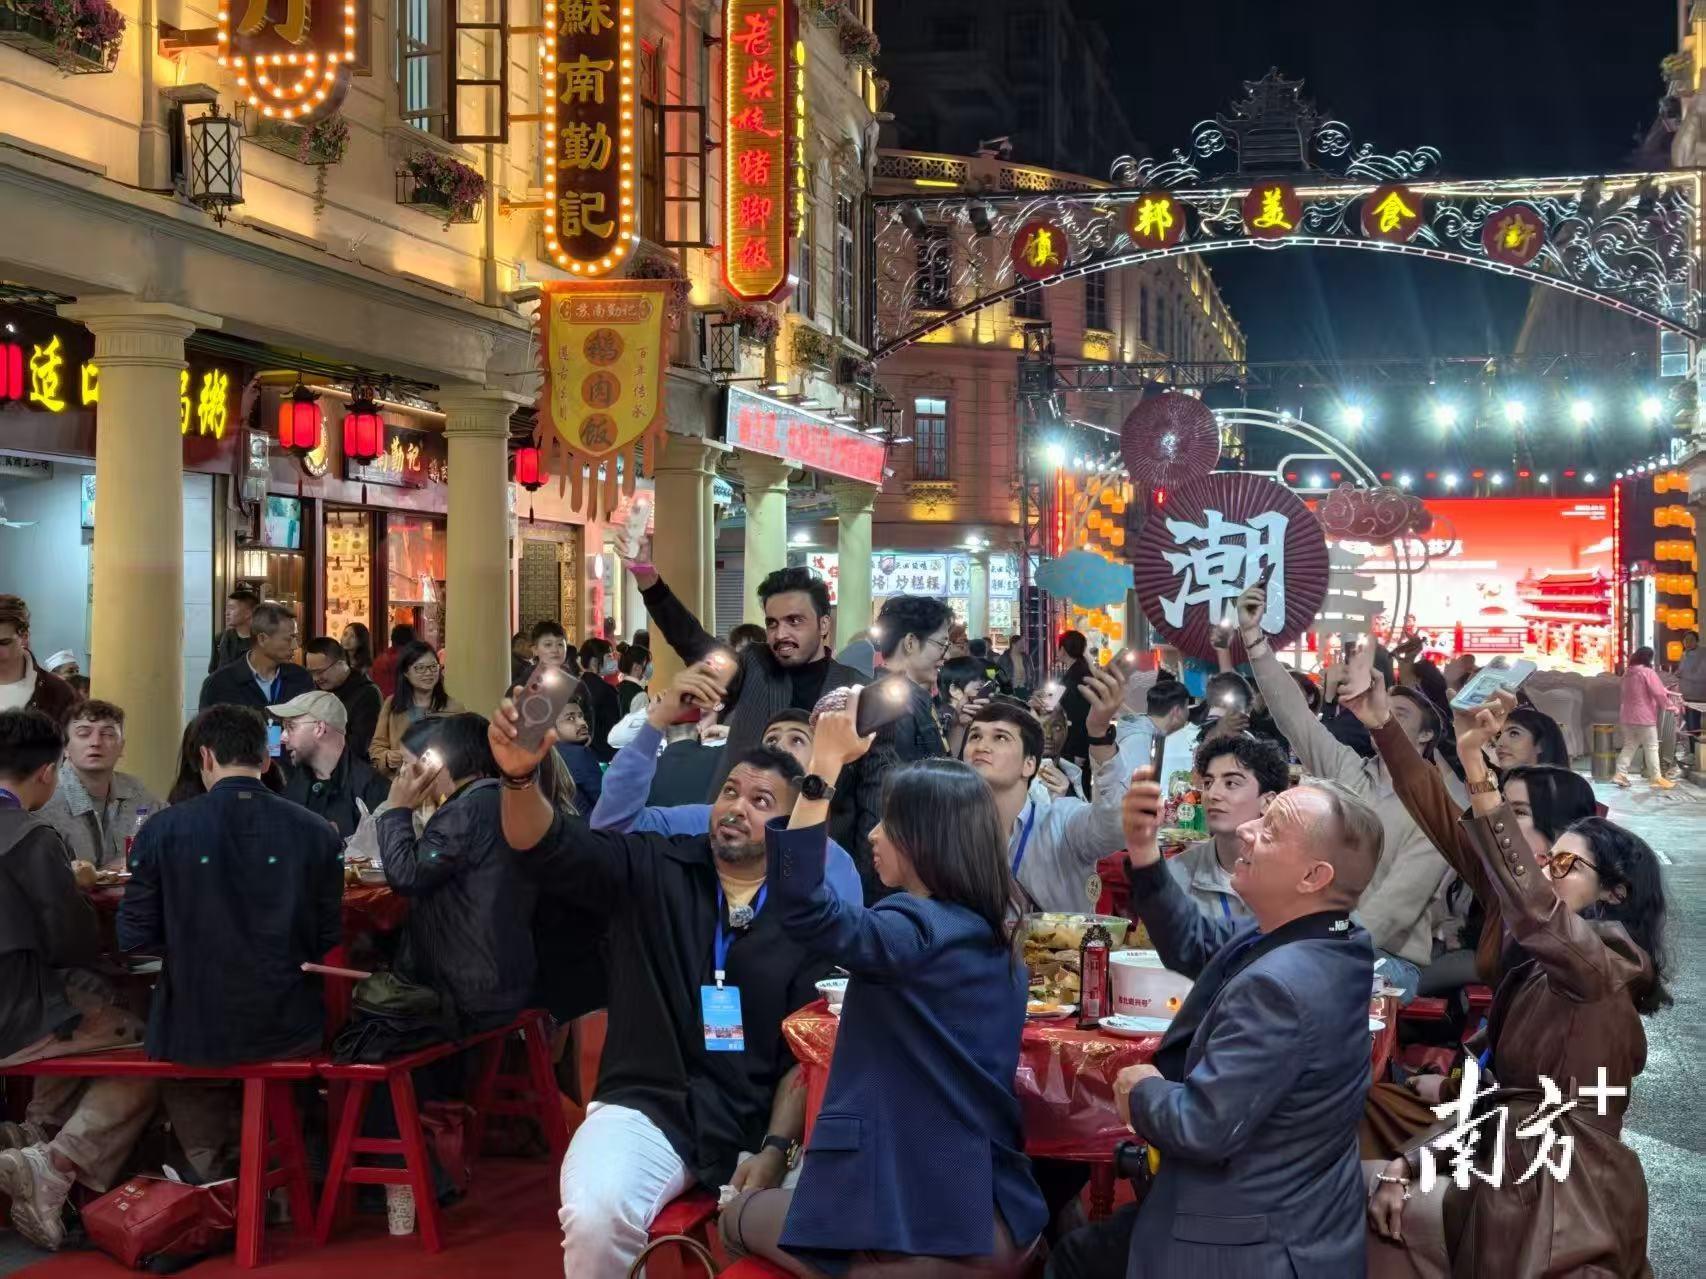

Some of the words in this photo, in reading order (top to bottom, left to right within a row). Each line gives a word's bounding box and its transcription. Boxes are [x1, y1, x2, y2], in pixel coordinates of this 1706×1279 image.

[557, 0, 615, 239] 蘇南勤記
[1159, 509, 1290, 635] 潮
